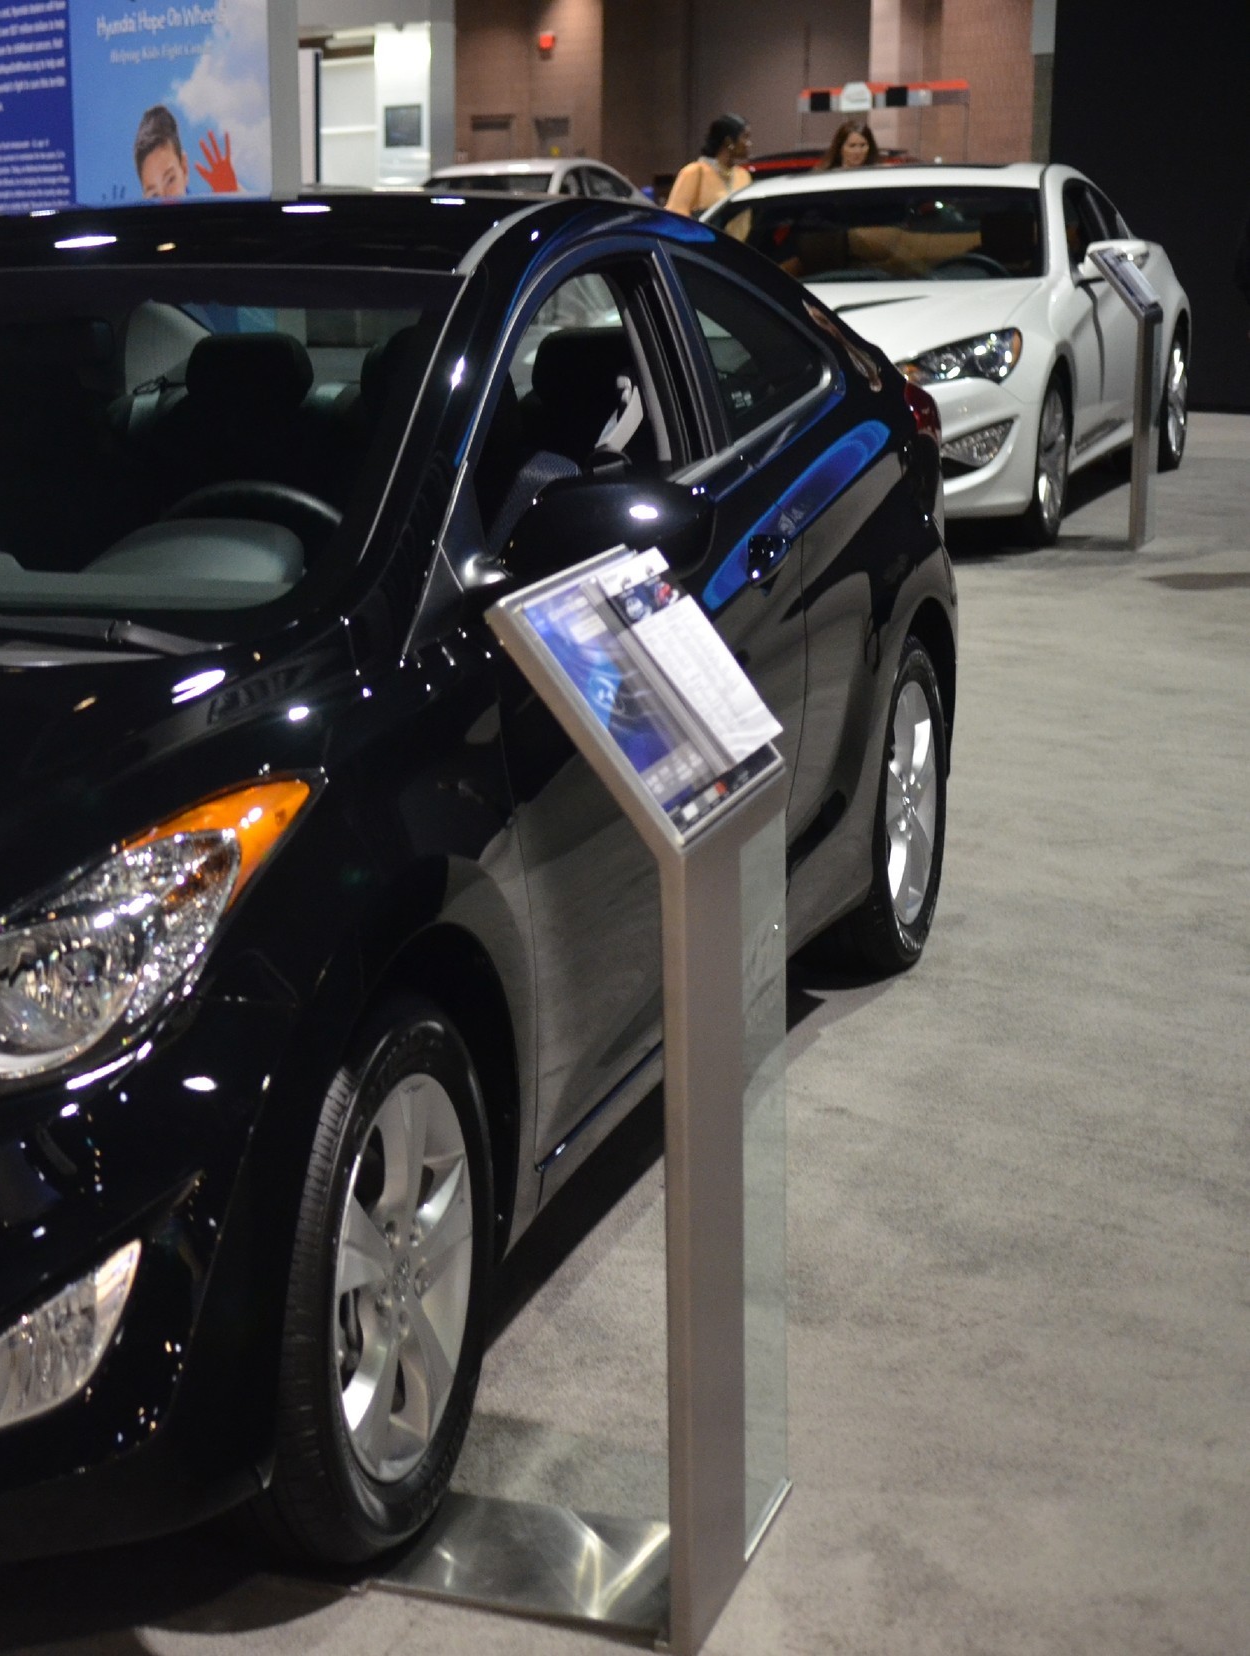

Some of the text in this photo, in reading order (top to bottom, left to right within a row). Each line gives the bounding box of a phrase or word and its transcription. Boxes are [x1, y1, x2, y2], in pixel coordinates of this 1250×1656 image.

[96, 12, 136, 41] Hyundai
[137, 8, 166, 36] Hope
[167, 6, 181, 27] On
